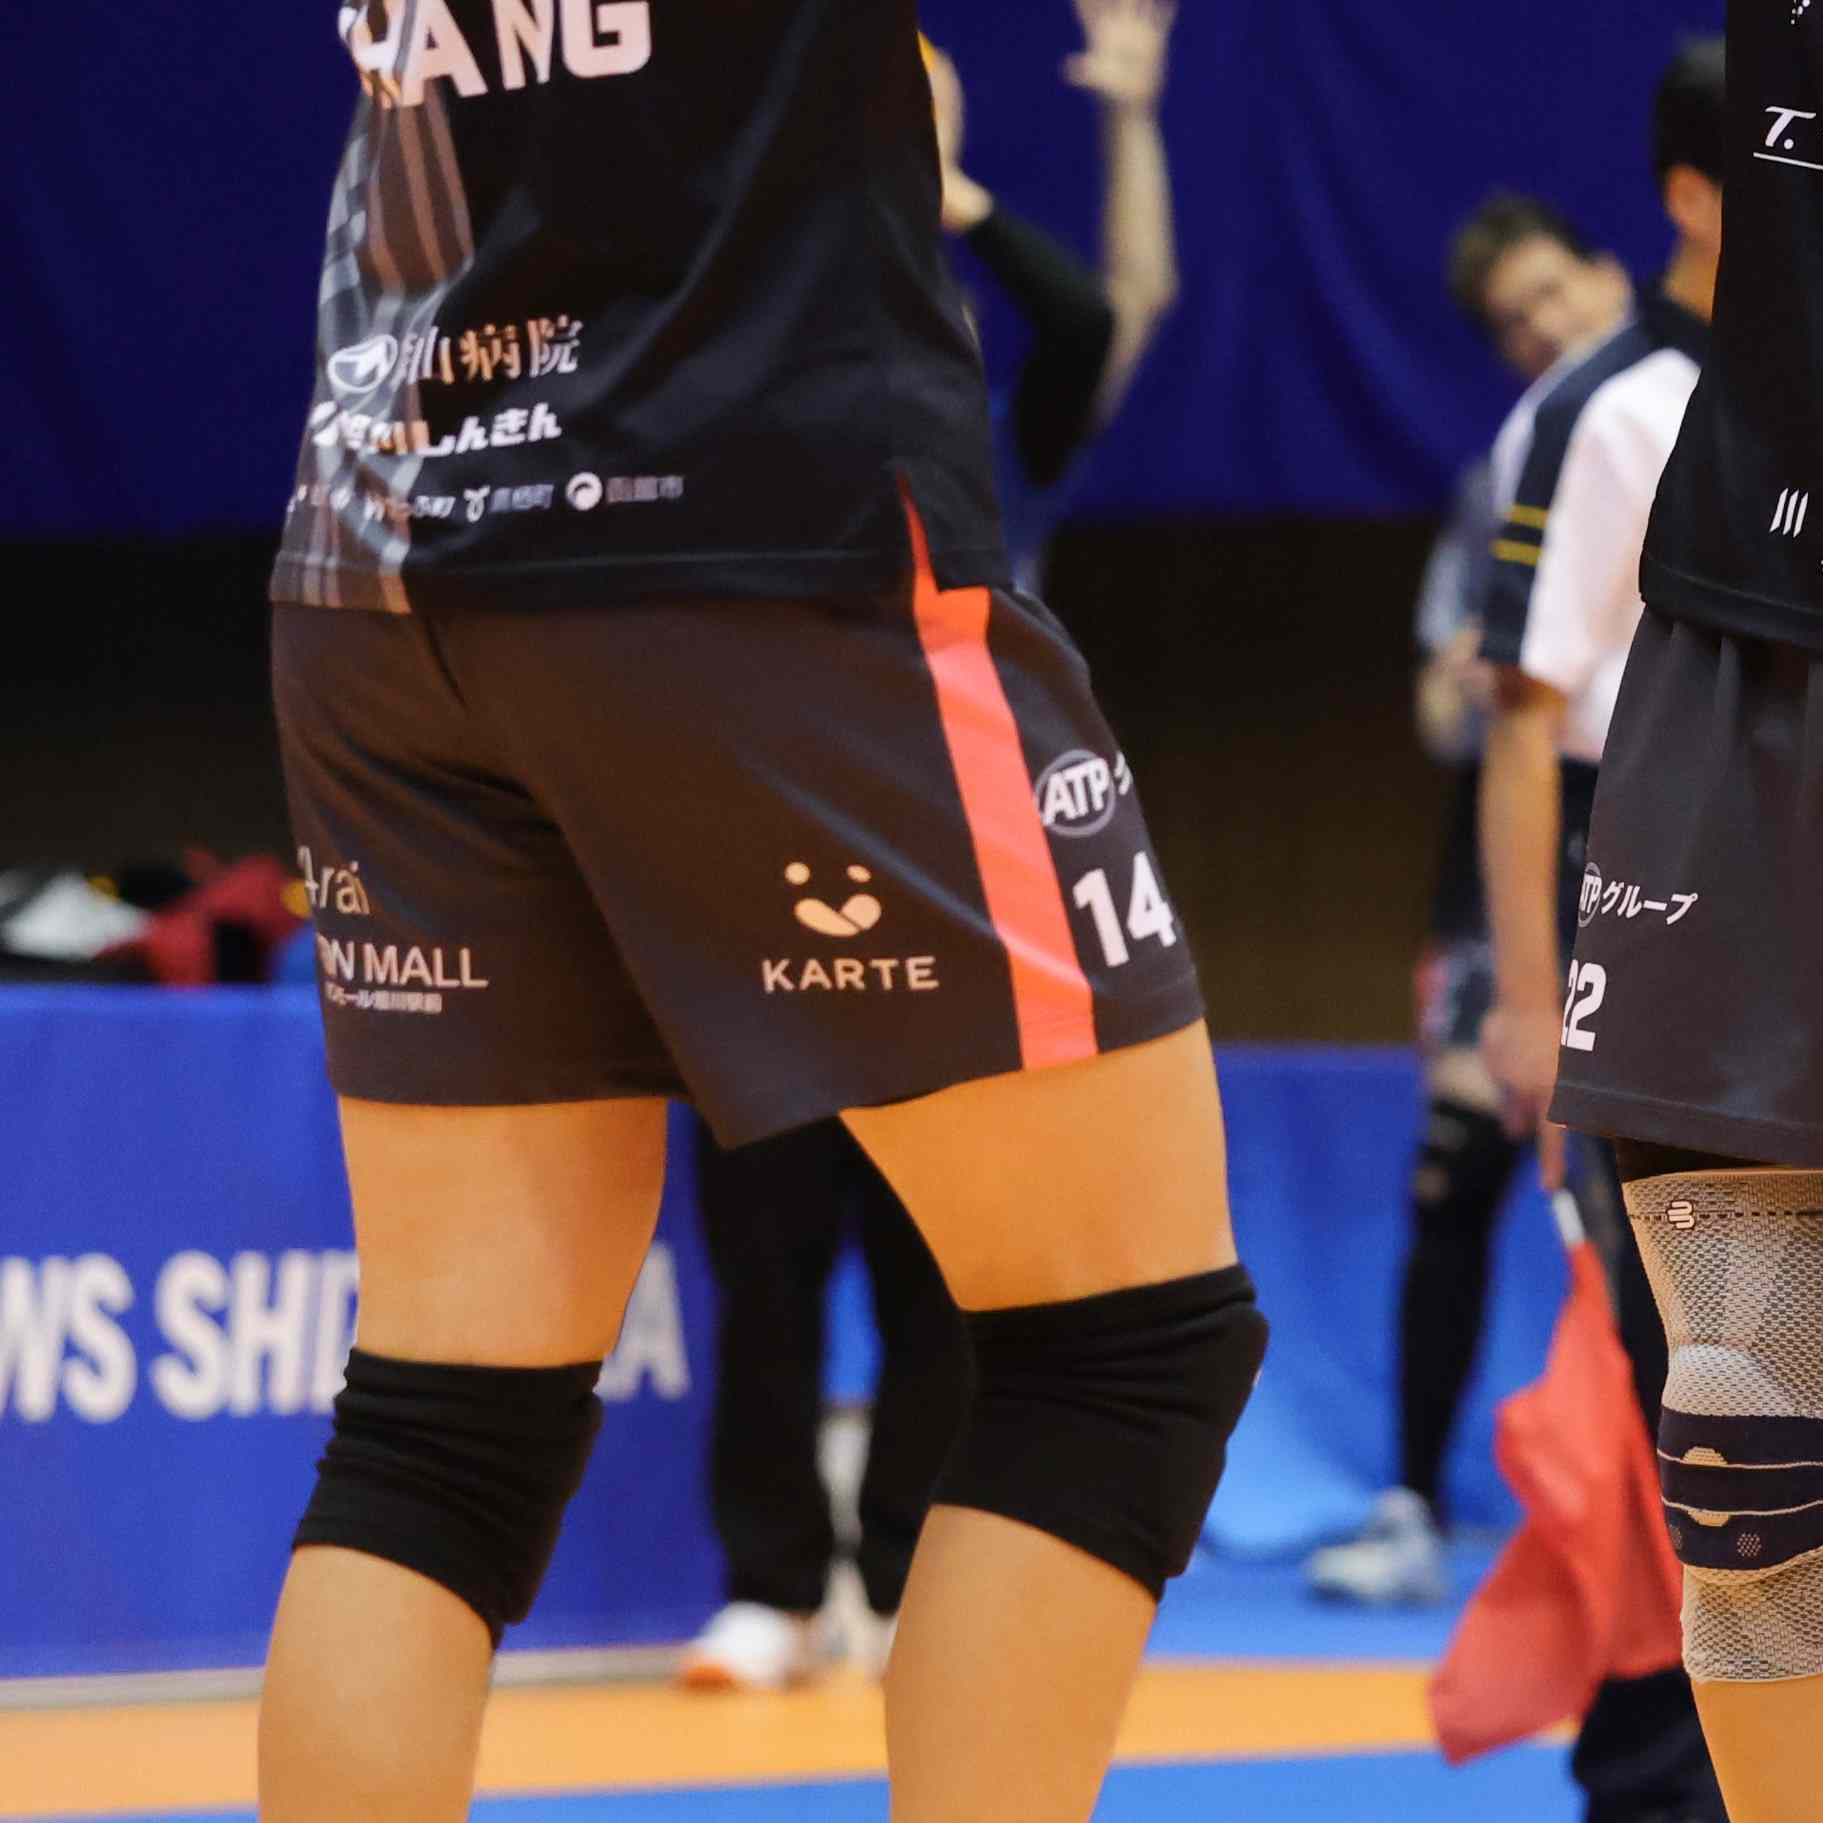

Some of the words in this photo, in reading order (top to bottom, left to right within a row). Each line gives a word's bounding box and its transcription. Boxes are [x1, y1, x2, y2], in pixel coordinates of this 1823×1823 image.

[1072, 850, 1177, 968] 14
[362, 941, 489, 989] MALL
[762, 955, 939, 992] KARTE
